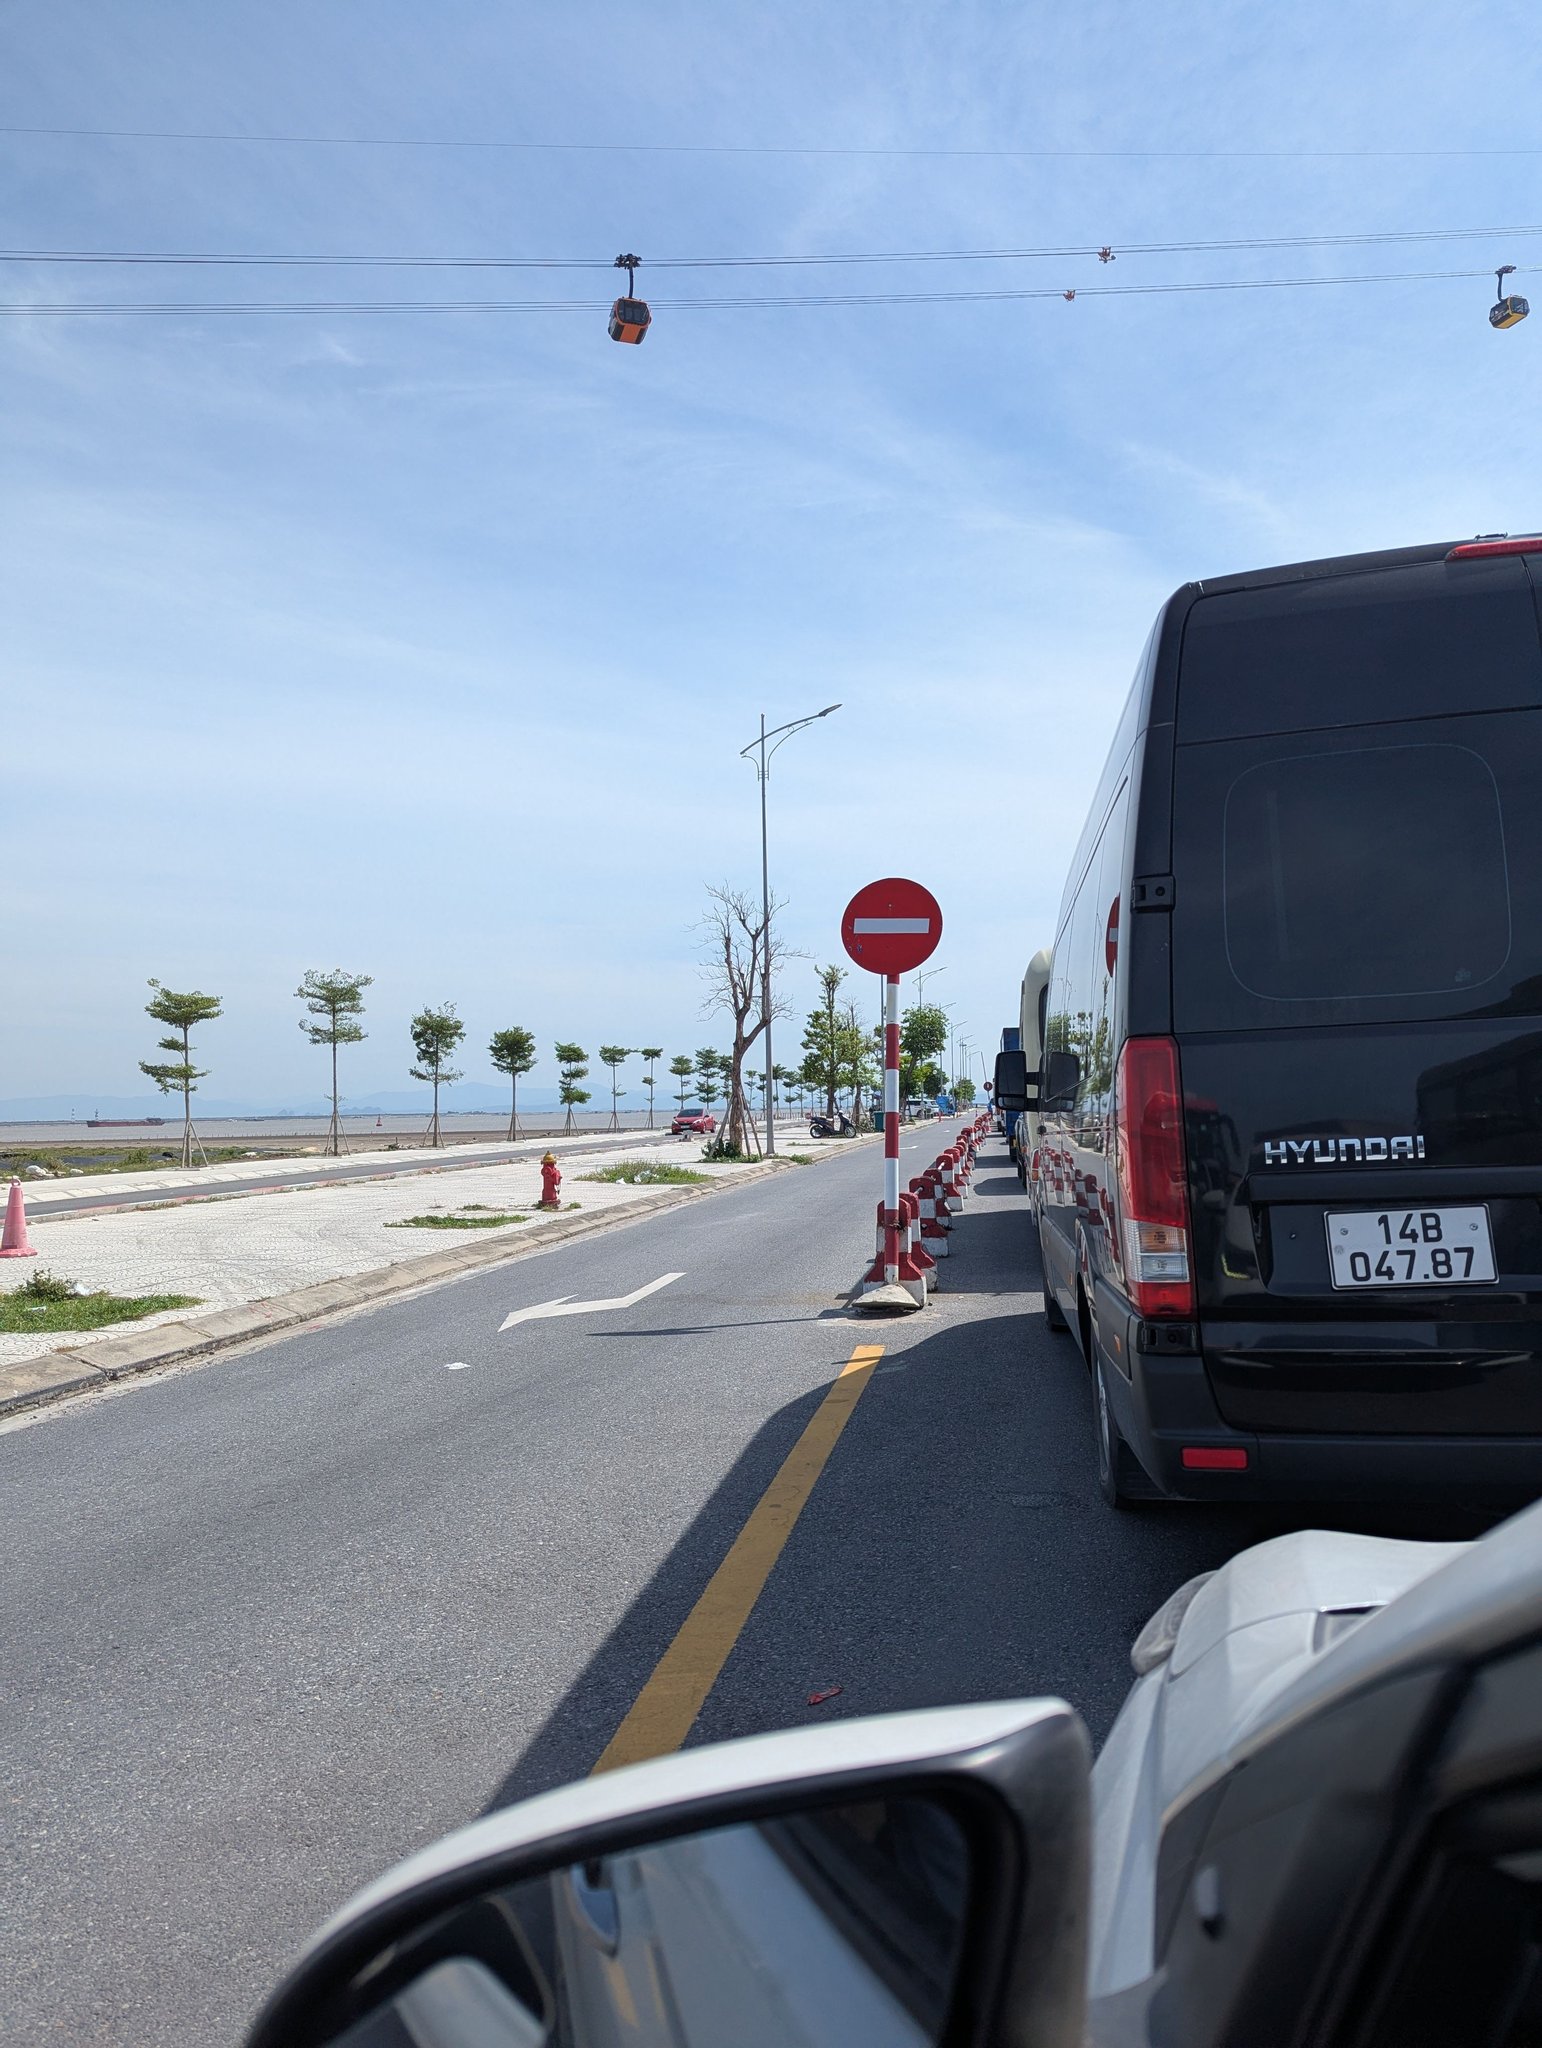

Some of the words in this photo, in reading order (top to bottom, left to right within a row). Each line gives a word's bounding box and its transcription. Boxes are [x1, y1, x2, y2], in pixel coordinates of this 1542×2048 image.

[1265, 1135, 1425, 1164] HYUNDAI
[1377, 1212, 1443, 1244] 14B
[1349, 1247, 1475, 1282] 047.87
